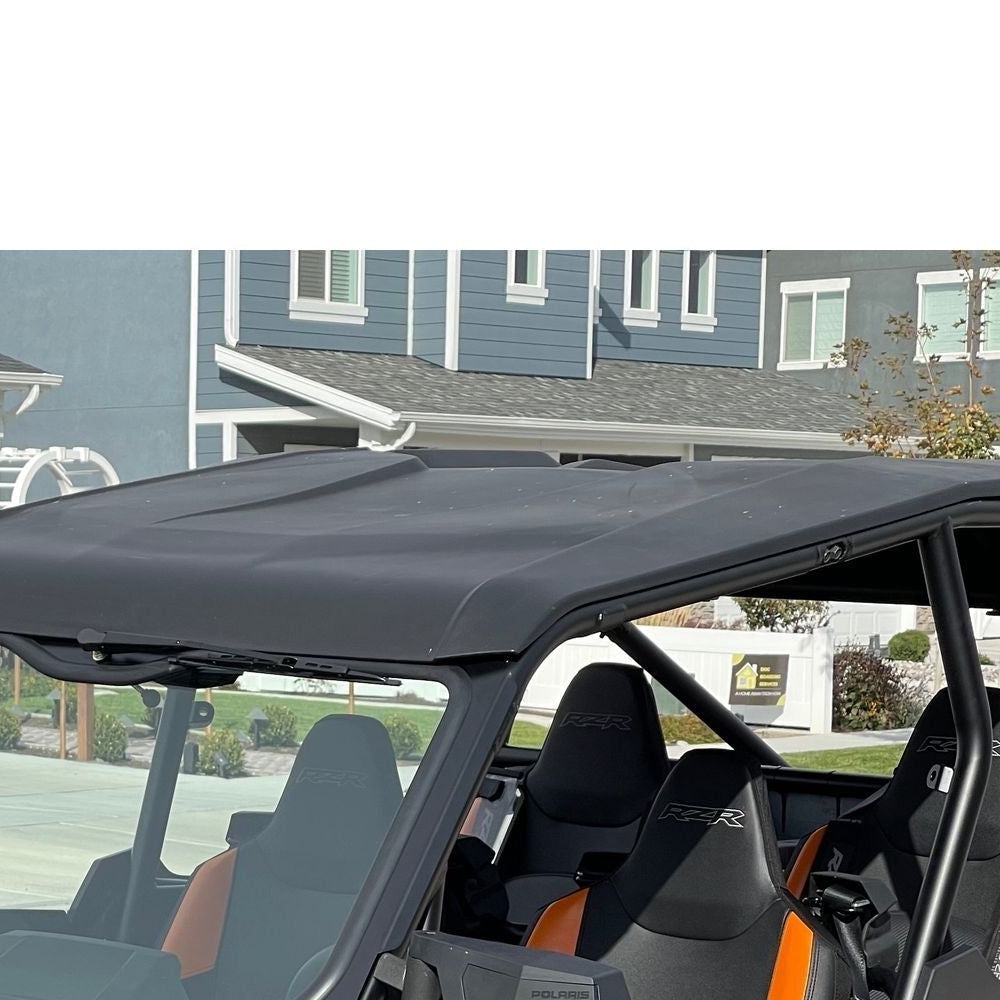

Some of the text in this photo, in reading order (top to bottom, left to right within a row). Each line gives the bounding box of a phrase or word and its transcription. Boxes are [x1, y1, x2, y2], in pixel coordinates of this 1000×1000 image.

[559, 712, 633, 731] RZR
[296, 767, 368, 788] RZR
[657, 802, 745, 828] RZR
[531, 990, 590, 1000] POLARIS
